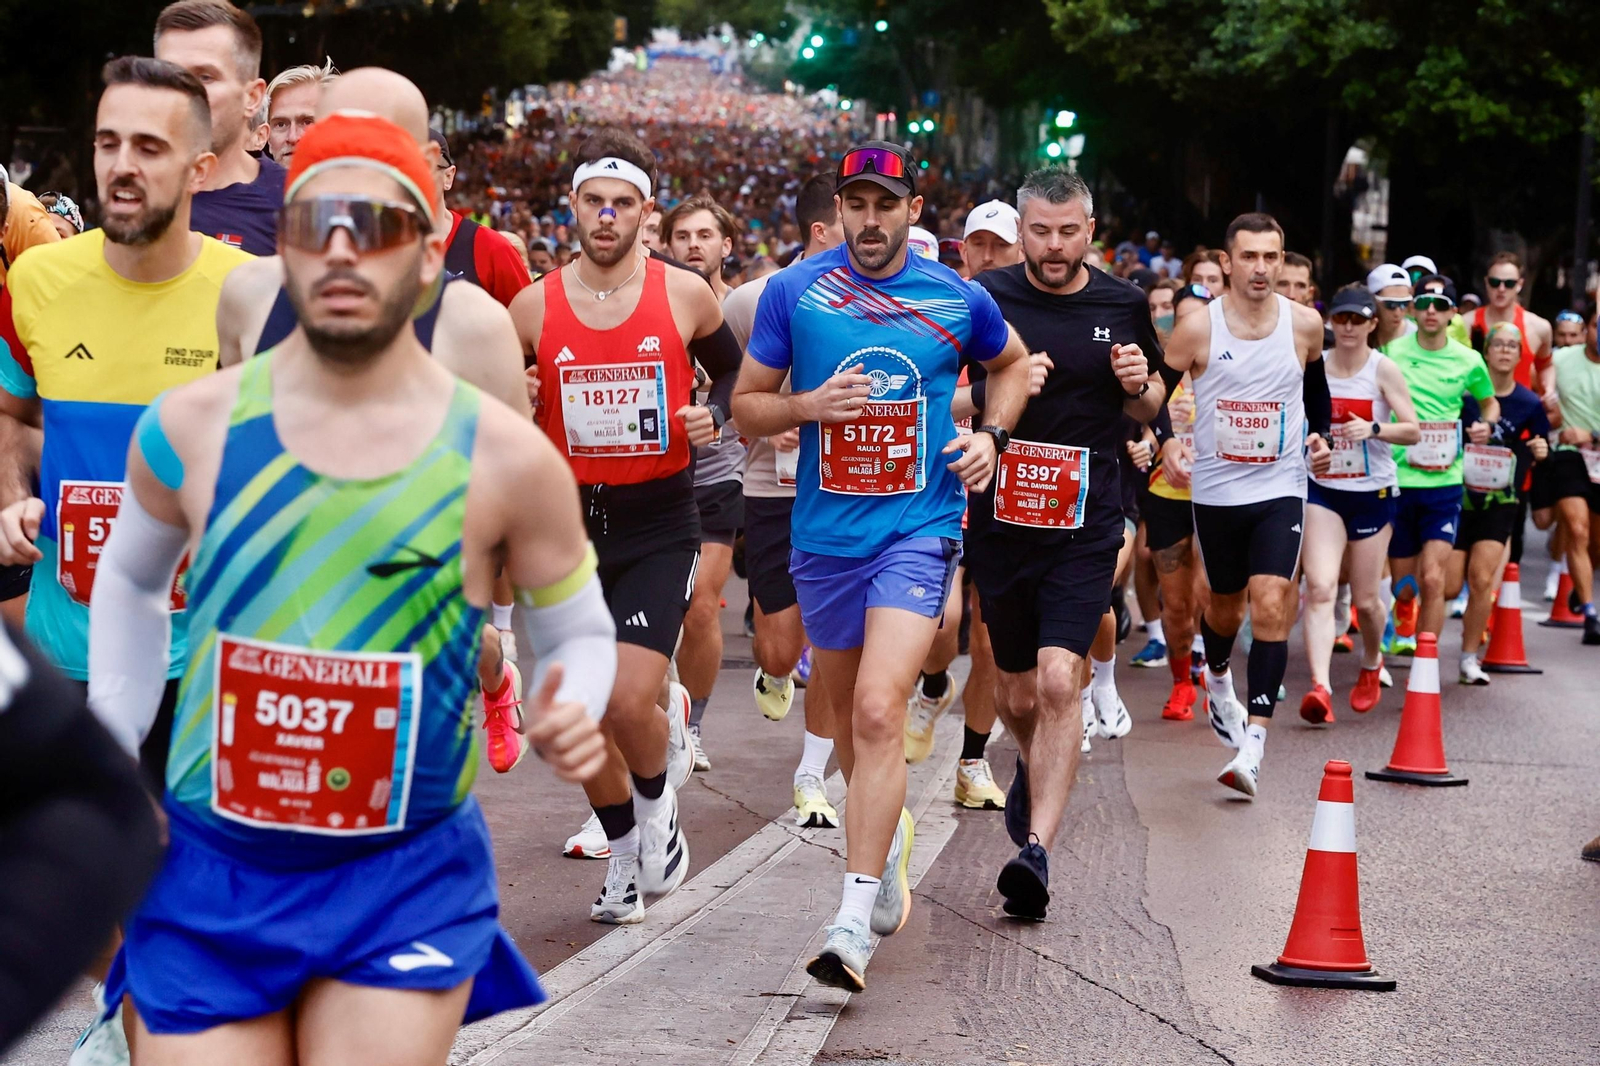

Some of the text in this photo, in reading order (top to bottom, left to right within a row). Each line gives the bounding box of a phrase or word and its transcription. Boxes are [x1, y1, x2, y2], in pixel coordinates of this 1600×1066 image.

[637, 336, 660, 352] AR
[166, 347, 213, 358] FIND YOUR
[164, 357, 204, 367] EVEREST
[587, 368, 648, 381] GENERALI
[582, 388, 640, 406] 18127
[860, 404, 911, 417] ENERALI
[1232, 402, 1276, 412] GENERALI
[1228, 416, 1269, 429] 18380
[843, 424, 896, 443] 5172
[1418, 433, 1448, 443] 7121
[856, 445, 881, 453] RAULO
[892, 448, 908, 456] 2070
[1021, 446, 1075, 462] GENERALI
[848, 466, 873, 475] MÁLAGA
[915, 462, 923, 475] BOX
[1016, 463, 1061, 482] 5397
[1016, 480, 1058, 491] NEIL DAVISON
[262, 652, 388, 688] GENERALI
[255, 690, 354, 734] 5037
